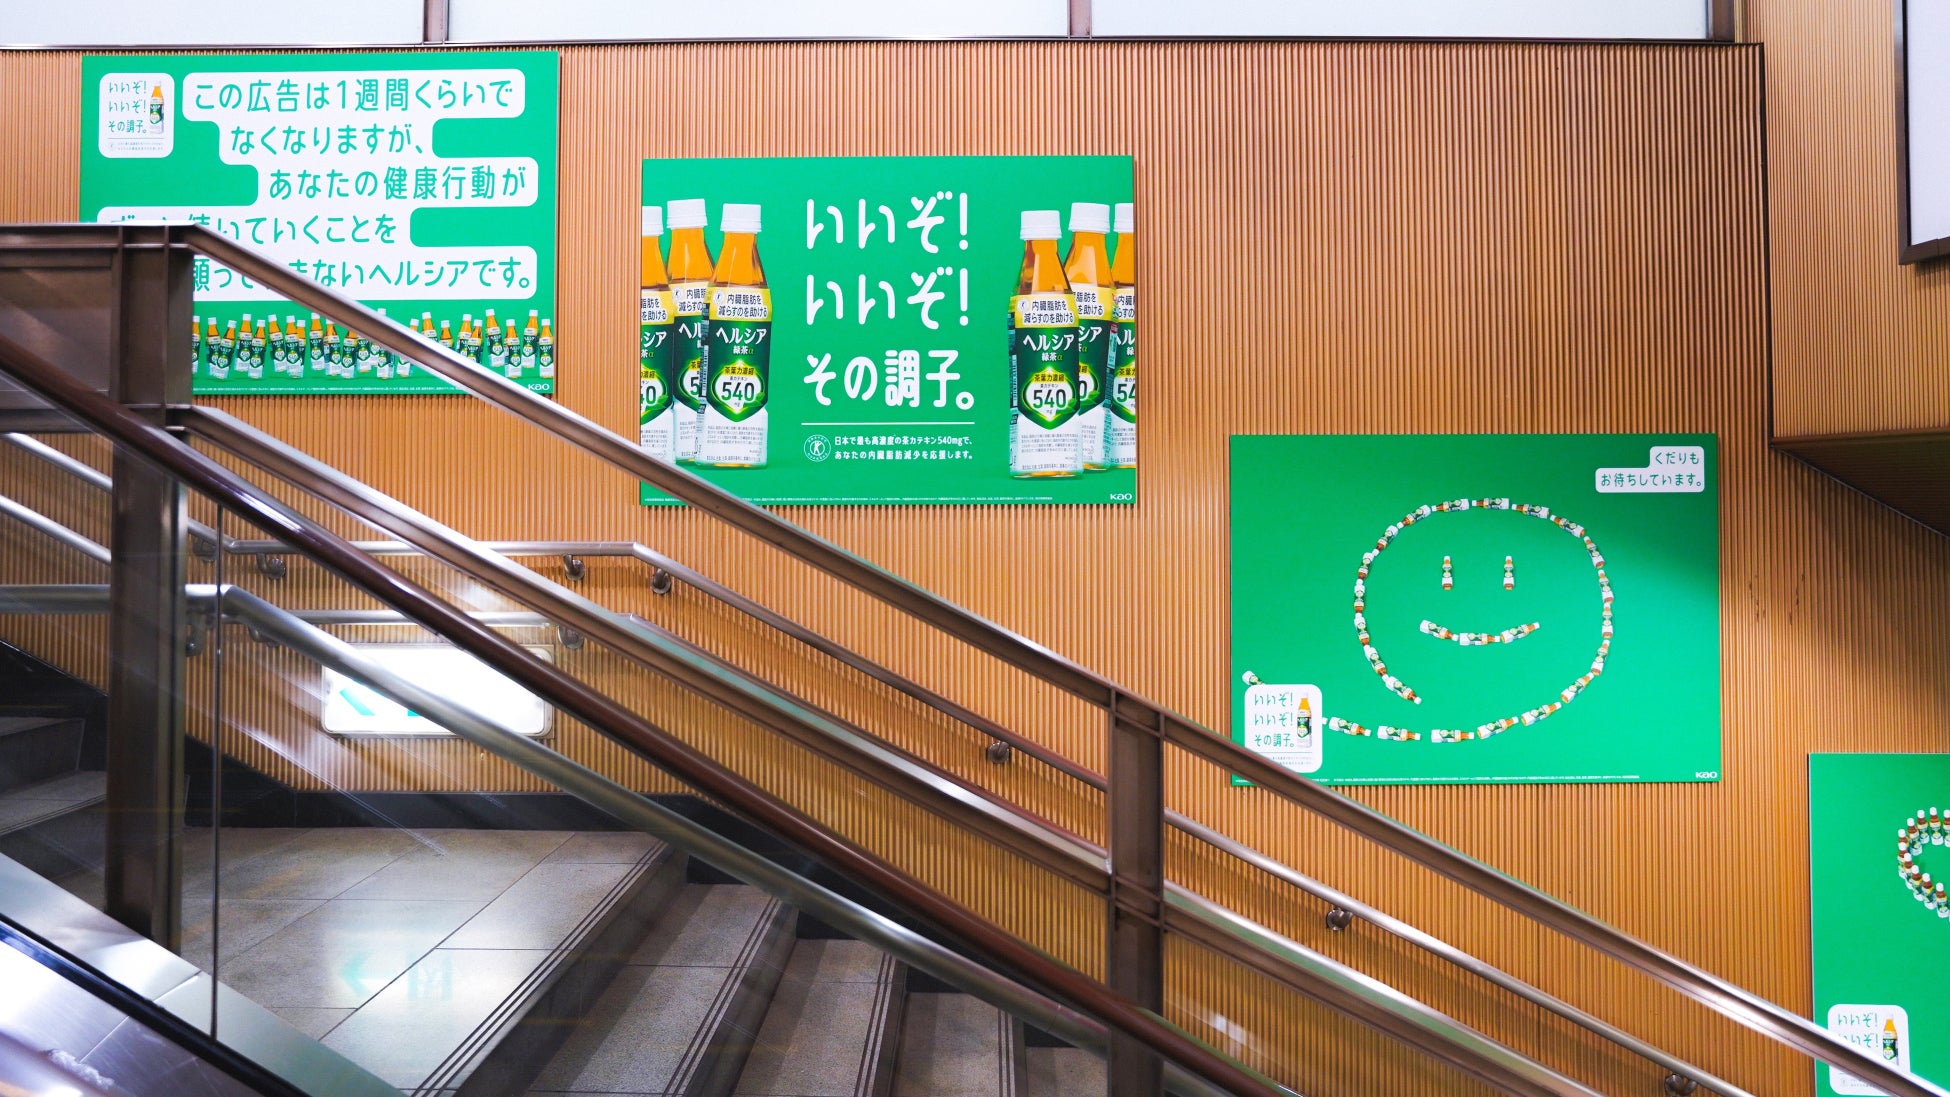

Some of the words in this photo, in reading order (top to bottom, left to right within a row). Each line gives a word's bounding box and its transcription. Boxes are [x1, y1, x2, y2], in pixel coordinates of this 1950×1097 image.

[109, 80, 147, 95] いいぞ!
[194, 79, 513, 113] この広告は1週間くらいで
[109, 99, 147, 114] いいぞ!
[108, 119, 147, 133] その調子。
[231, 124, 425, 156] なくなりますが、
[269, 165, 526, 200] あなたの健康行動が
[806, 190, 968, 254] いいぞ!
[806, 266, 968, 330] いいぞ!
[715, 327, 767, 345] ヘルシア
[1022, 334, 1075, 351] ヘルシア
[803, 349, 974, 410] その調子。
[721, 381, 755, 402] 540
[1033, 389, 1067, 409] 540
[834, 435, 973, 447] 日本で最も高濃度の茶カテキン540mgで、
[834, 450, 973, 460] あなたの内臓脂肪減少を応援します。
[1655, 452, 1700, 465] くだりも
[1601, 473, 1702, 488] お待ちしています。
[1254, 692, 1294, 707] いいぞ!
[1254, 712, 1294, 727] いいぞ!
[1254, 733, 1295, 748] その調子。
[1837, 1012, 1878, 1028] いいぞ!
